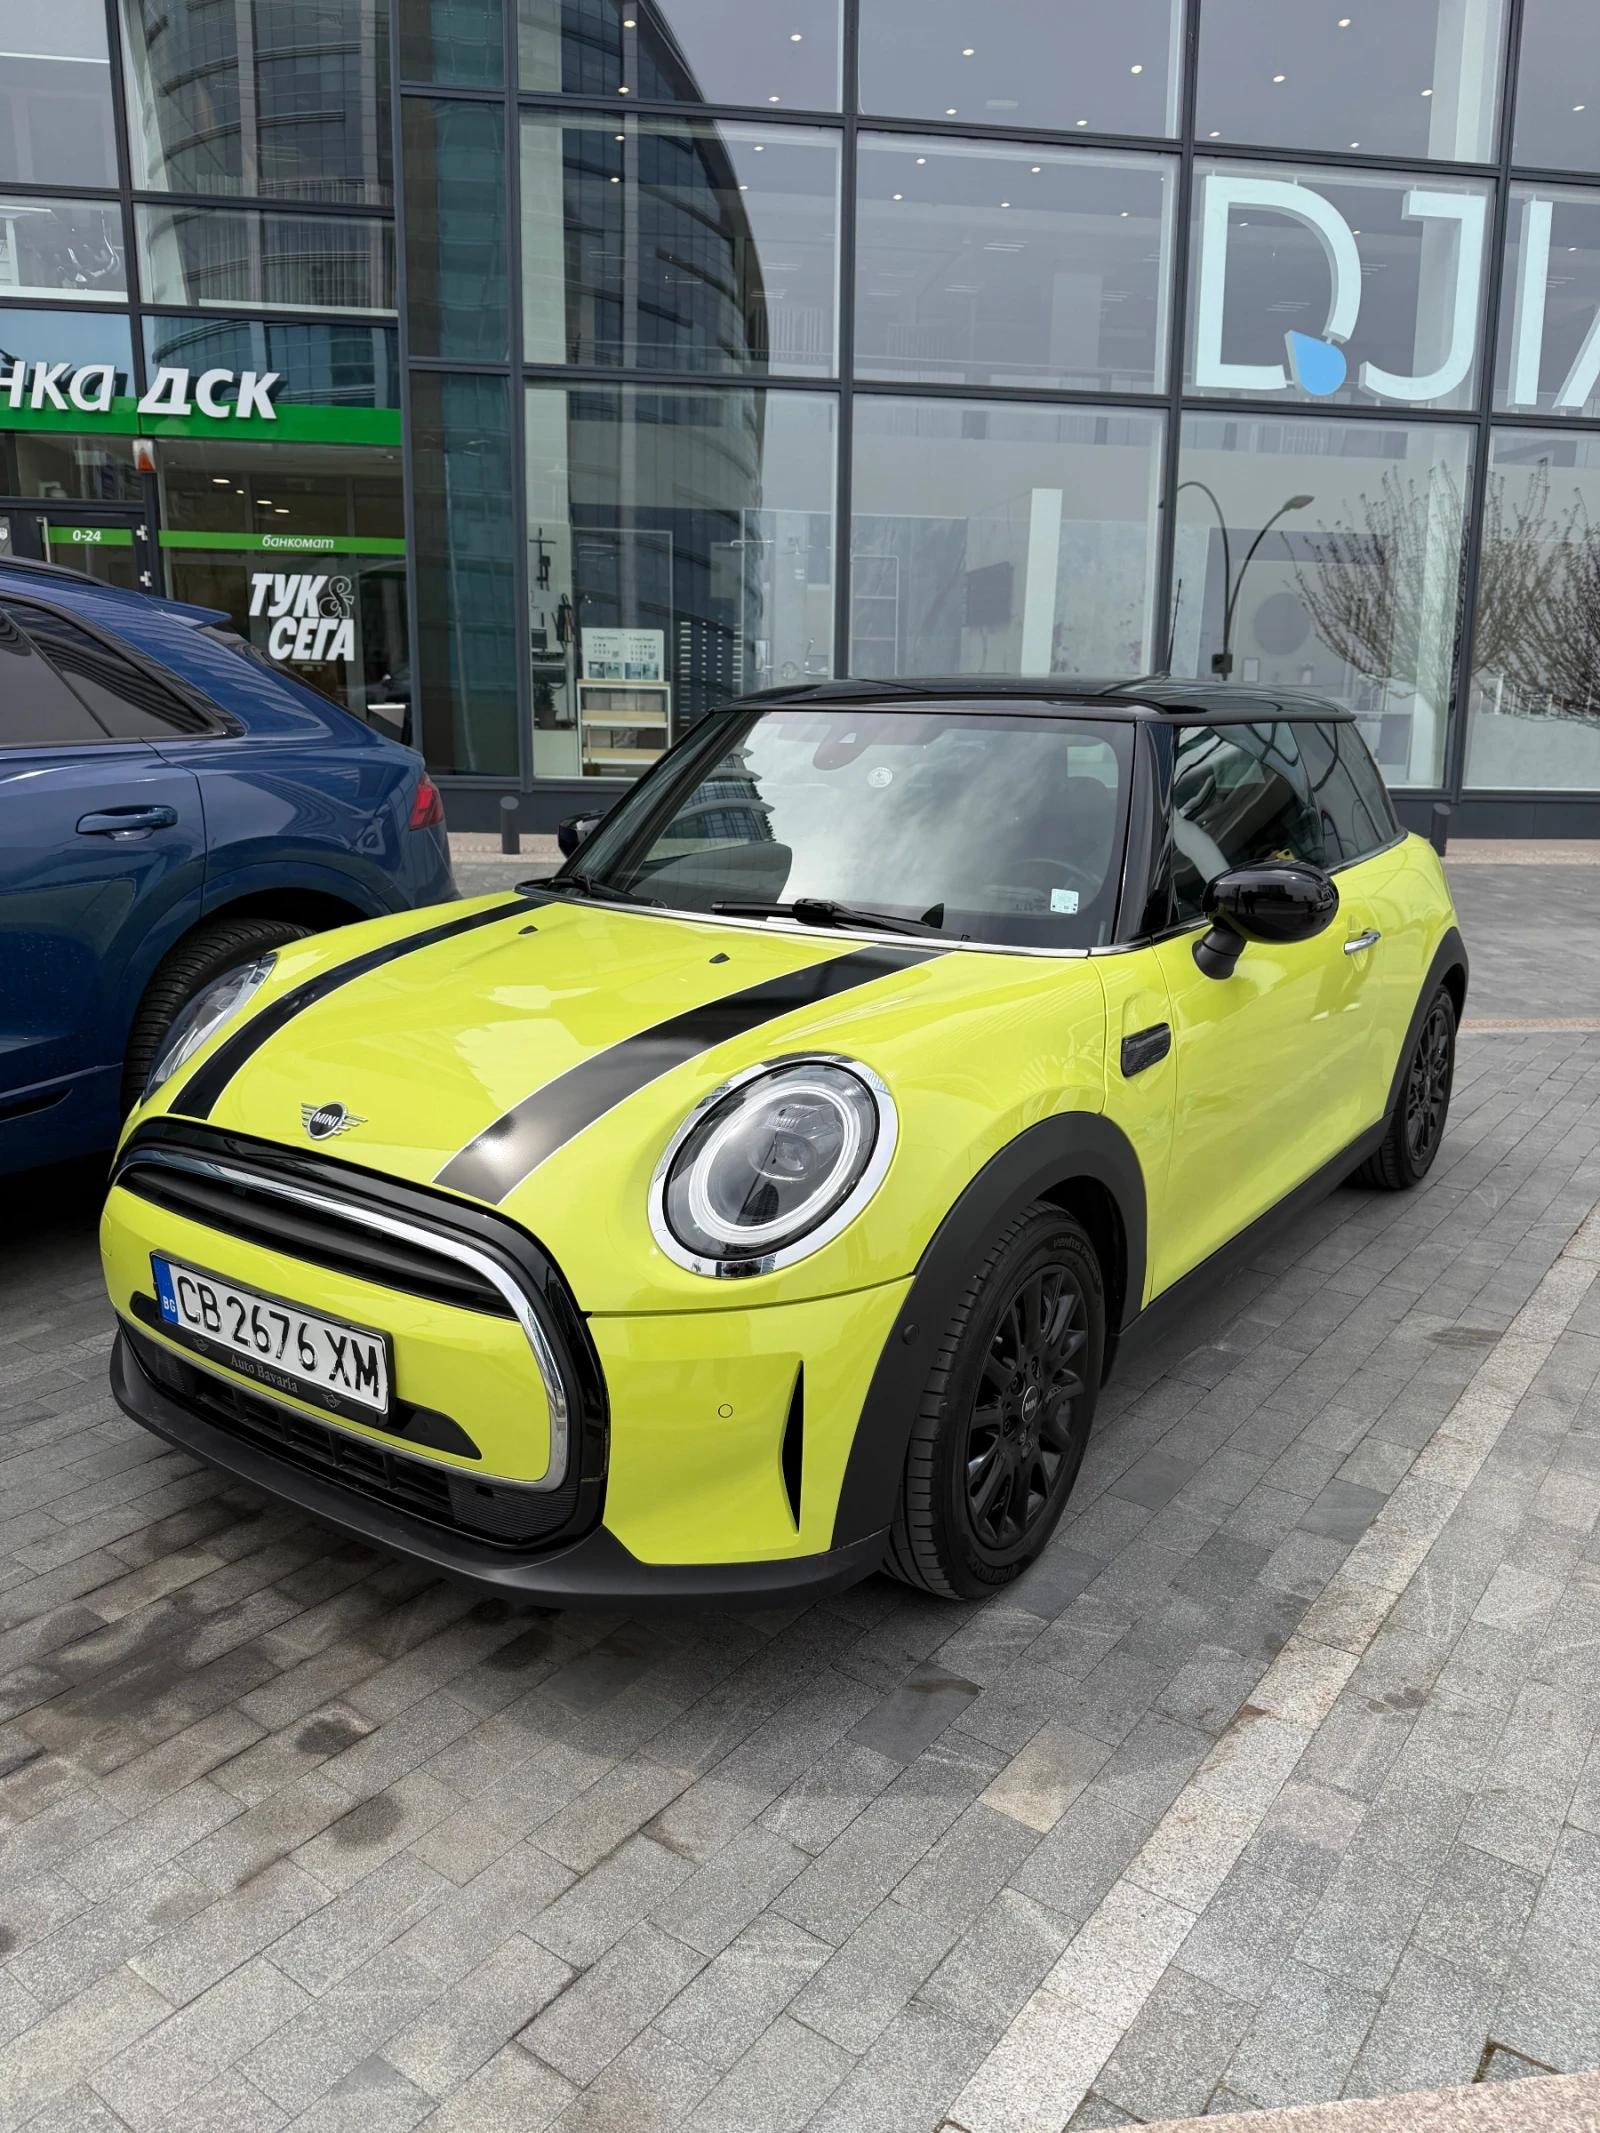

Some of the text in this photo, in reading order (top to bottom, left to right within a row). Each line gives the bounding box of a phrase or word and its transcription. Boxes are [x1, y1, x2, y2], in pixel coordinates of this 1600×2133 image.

[72, 529, 102, 542] 0-24
[262, 534, 334, 549] банкомат
[268, 616, 355, 662] СЕГА
[312, 1112, 340, 1127] MINI
[162, 1295, 177, 1313] BG
[177, 1275, 380, 1398] CB 2676 XM
[231, 1354, 299, 1393] Auto Bavaria
